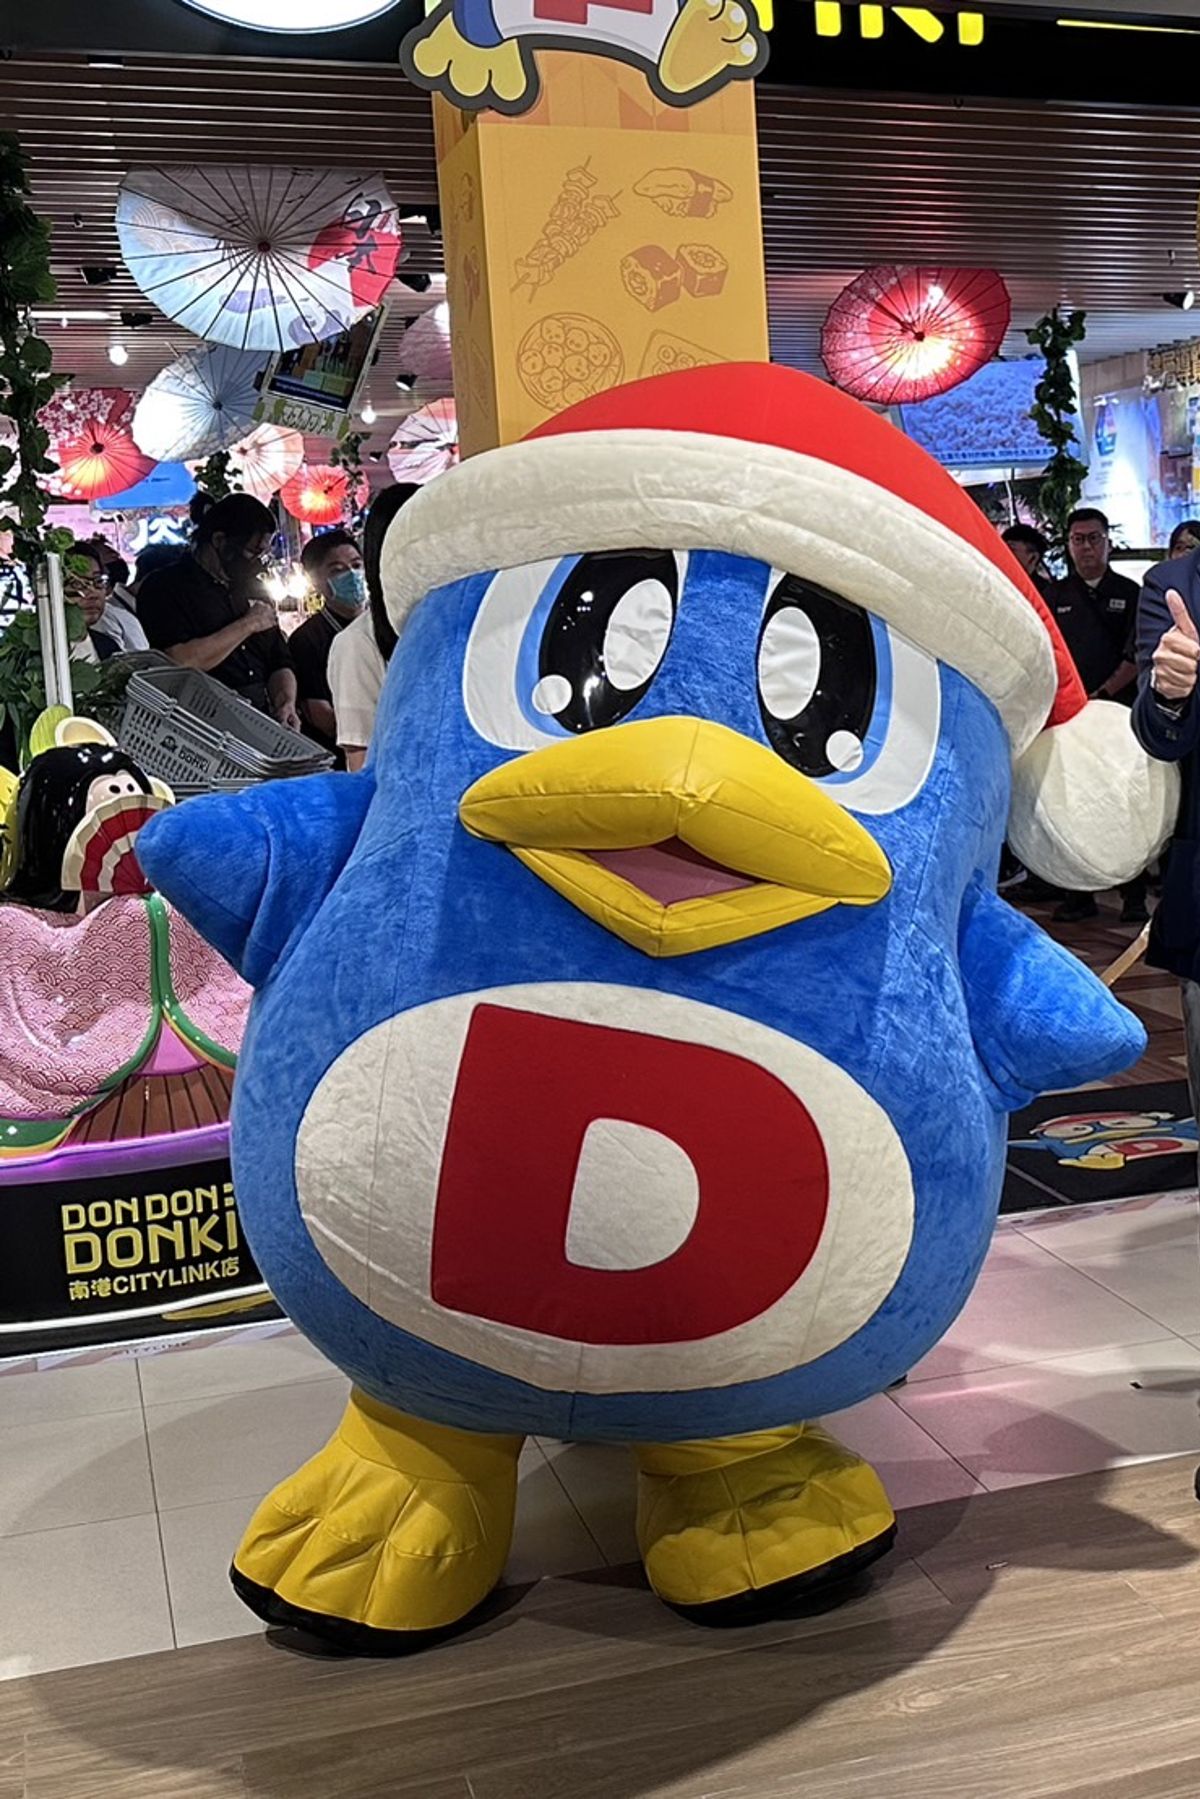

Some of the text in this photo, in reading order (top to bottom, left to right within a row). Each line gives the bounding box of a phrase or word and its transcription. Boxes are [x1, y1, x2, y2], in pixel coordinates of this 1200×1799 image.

[431, 1002, 829, 1345] D
[61, 1198, 140, 1232] DON
[63, 1210, 238, 1275] DONKI
